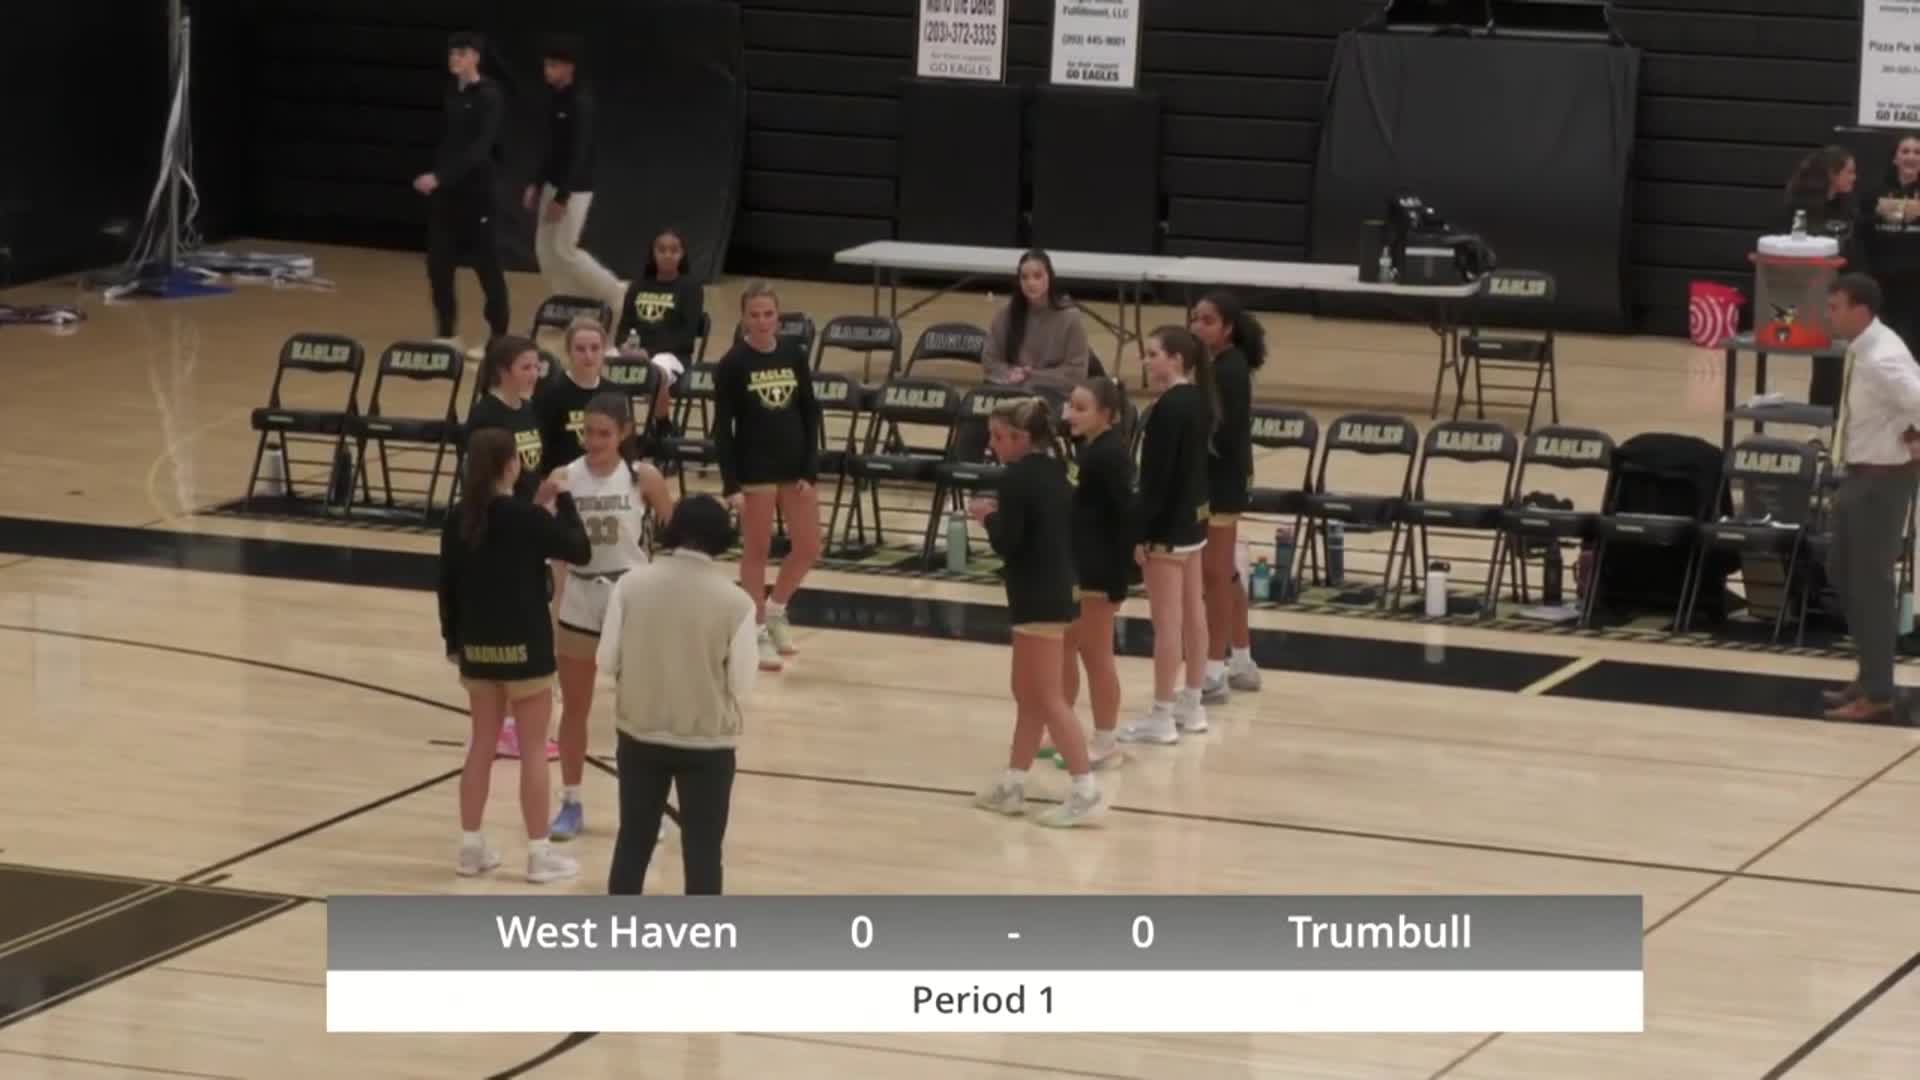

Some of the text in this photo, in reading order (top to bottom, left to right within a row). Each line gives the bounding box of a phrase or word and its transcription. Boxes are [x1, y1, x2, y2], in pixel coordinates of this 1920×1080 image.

[1065, 69, 1119, 81] GO EAGLES
[1489, 277, 1547, 296] EAGLES
[290, 341, 351, 363] EAGLES
[390, 351, 450, 371] EAGLES
[751, 367, 796, 383] EAGLES
[885, 387, 947, 408] EAGLES
[1251, 416, 1305, 438] AGLES
[1337, 423, 1405, 443] EAGLES
[1436, 430, 1504, 452] EAGLES
[1534, 436, 1604, 459] EAGLES
[1734, 449, 1802, 473] EAGLES
